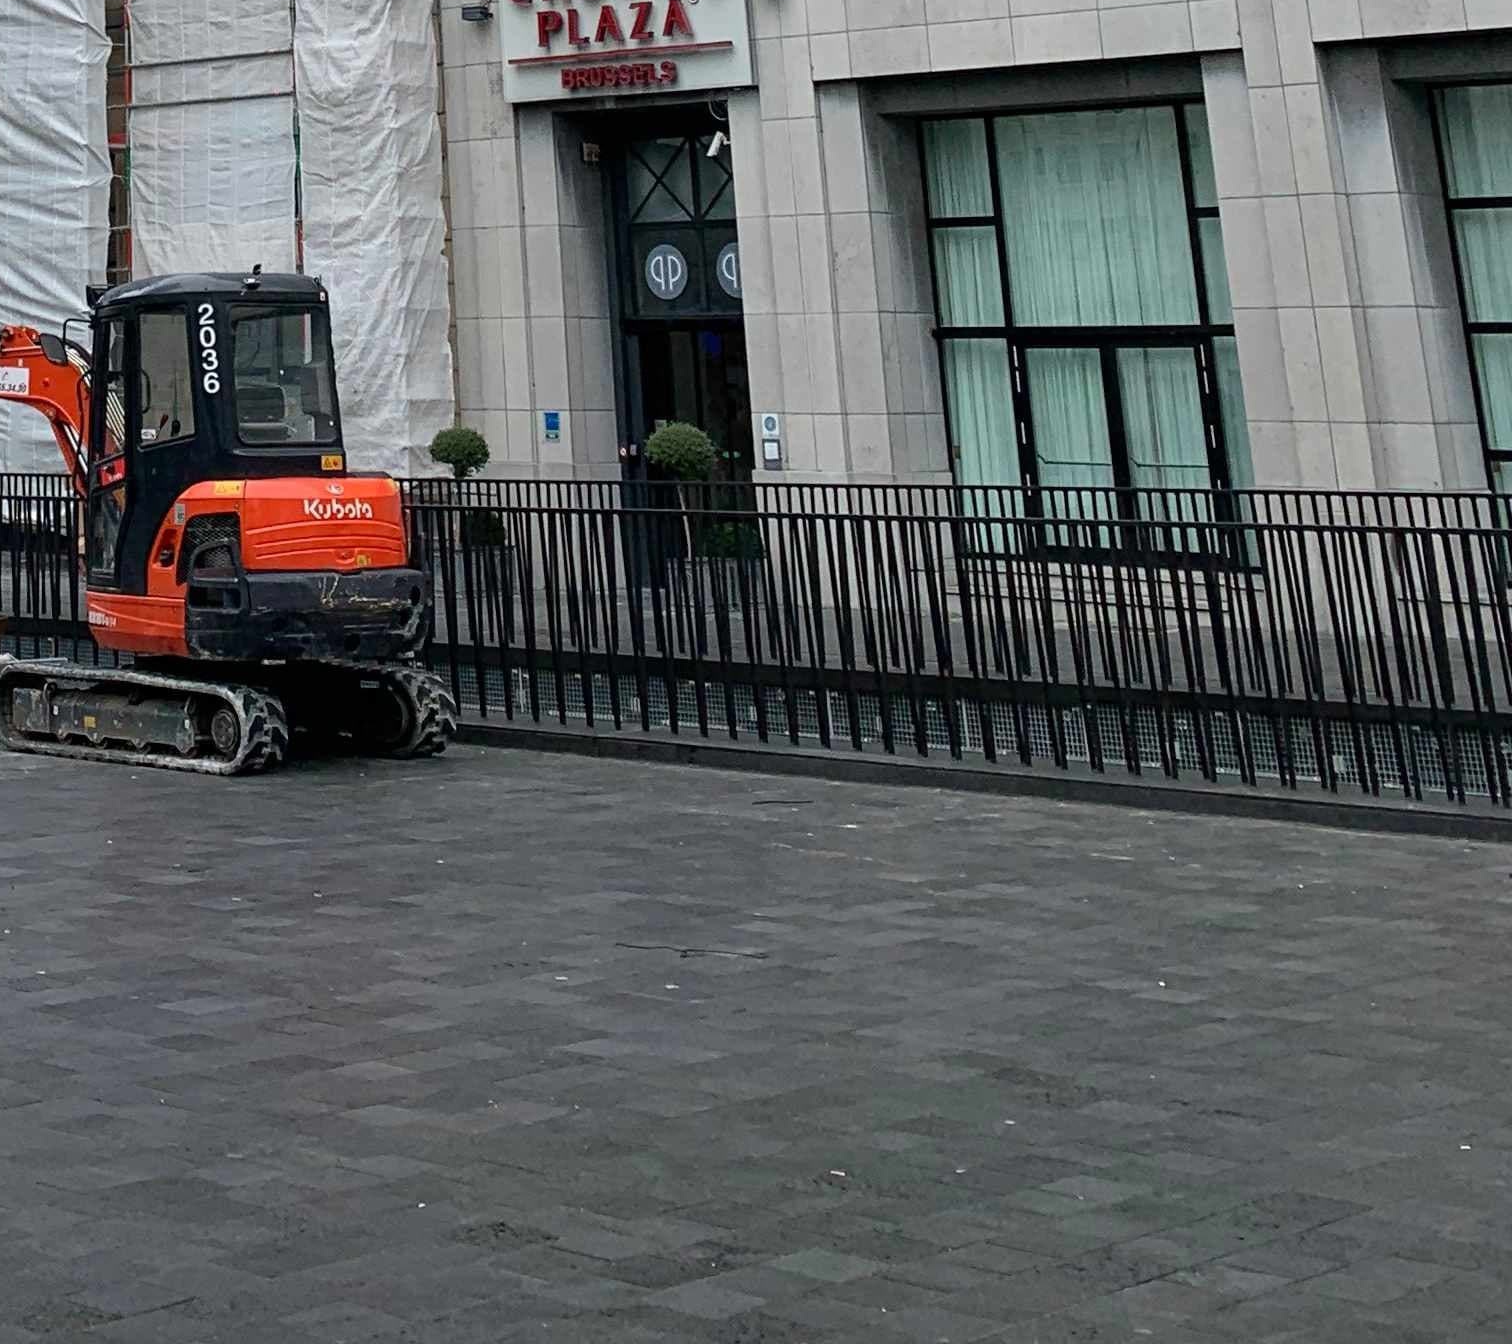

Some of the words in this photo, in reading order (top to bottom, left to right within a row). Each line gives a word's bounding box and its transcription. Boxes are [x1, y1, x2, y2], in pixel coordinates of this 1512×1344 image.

[561, 60, 678, 90] BRUSSELS
[197, 303, 221, 394] 2036
[303, 497, 373, 520] Kubota
